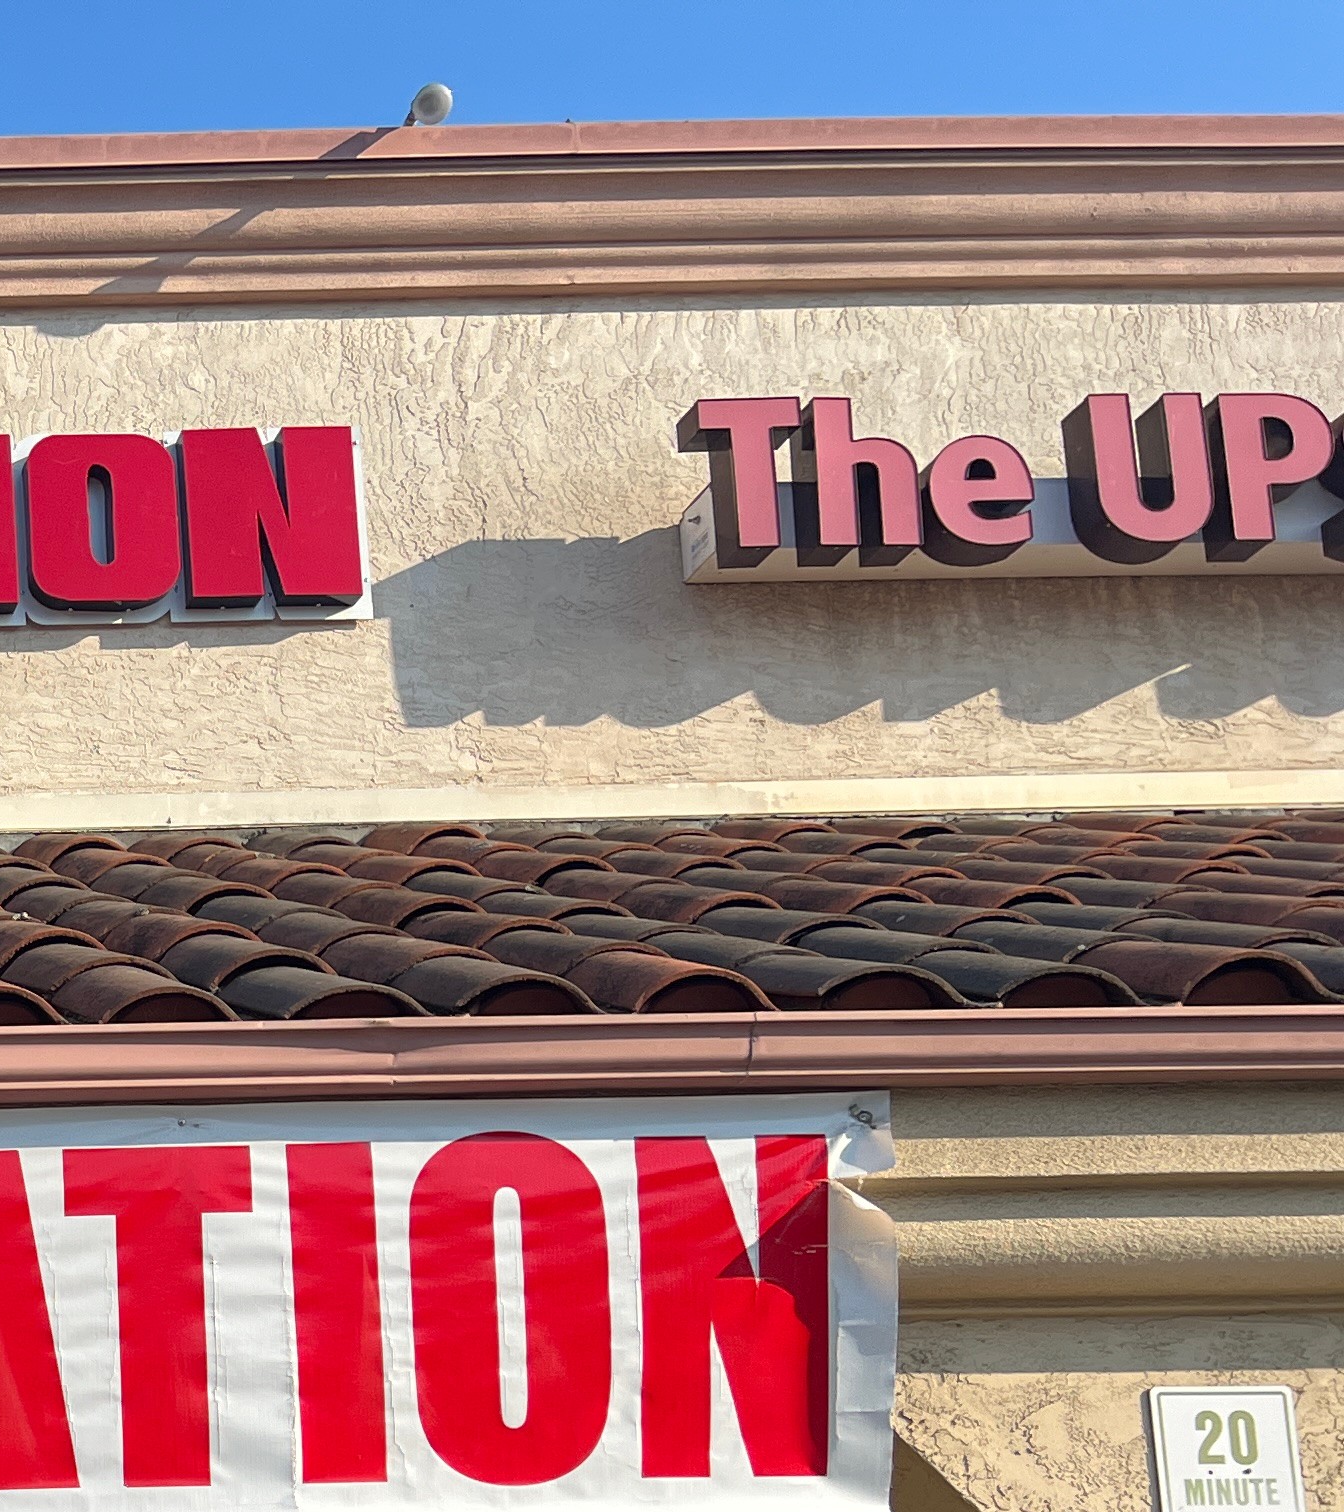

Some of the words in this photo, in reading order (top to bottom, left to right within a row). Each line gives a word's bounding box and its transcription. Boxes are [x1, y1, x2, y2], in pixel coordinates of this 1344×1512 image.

[678, 396, 1033, 567] The
[1062, 391, 1344, 566] UP
[1194, 1409, 1260, 1466] 20
[1183, 1477, 1282, 1507] MINUTE
